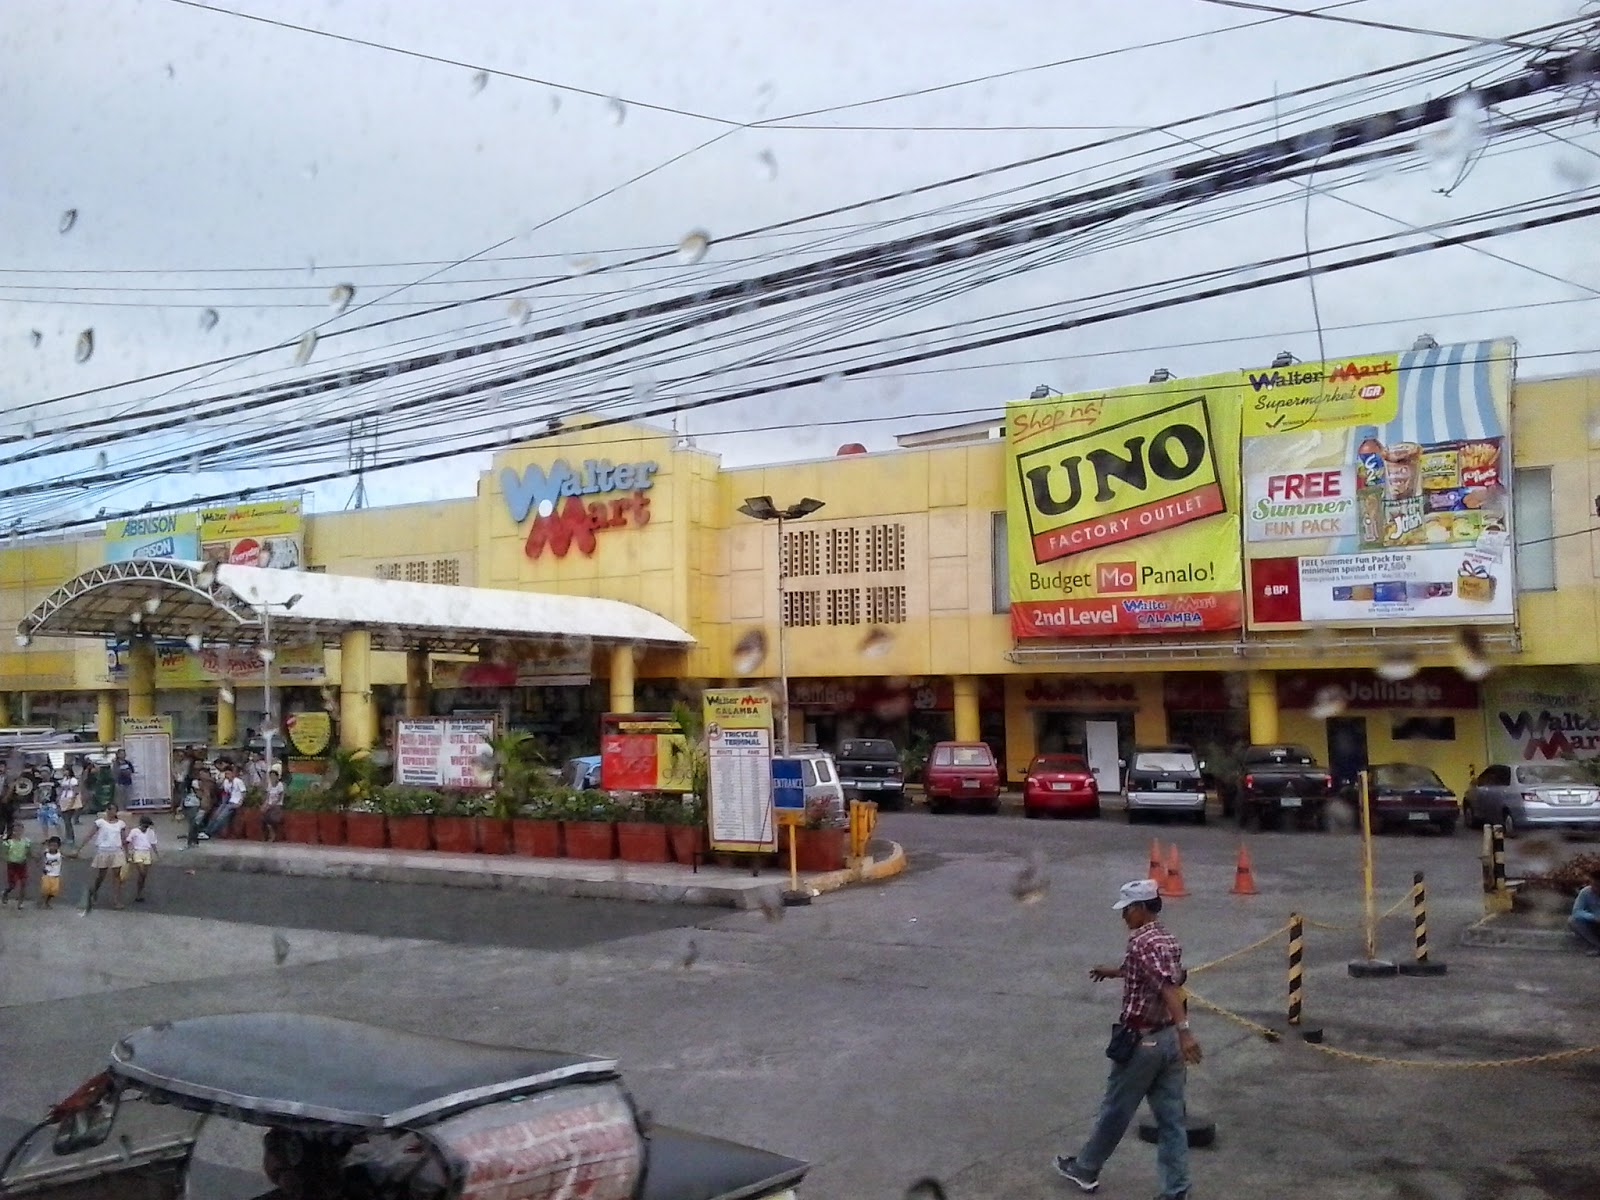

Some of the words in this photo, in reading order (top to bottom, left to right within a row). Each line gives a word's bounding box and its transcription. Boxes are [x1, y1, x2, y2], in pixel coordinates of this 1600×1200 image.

[1249, 370, 1323, 391] Walter
[1329, 361, 1392, 383] Mart
[1255, 385, 1356, 413] Supermarket
[1360, 385, 1382, 397] IGA
[1013, 408, 1065, 436] Shop
[1026, 424, 1205, 515] UNO
[501, 459, 658, 522] Walter
[1268, 471, 1341, 501] FREE
[1252, 498, 1351, 523] Summer
[121, 514, 177, 538] ABENSON
[525, 490, 650, 559] Mart
[1049, 516, 1129, 551] FACTORY
[1139, 496, 1204, 526] OUTLET
[1264, 520, 1295, 536] FUN
[1302, 518, 1340, 534] PACK
[1301, 567, 1340, 575] minimum
[1341, 564, 1366, 574] spend
[1372, 555, 1390, 563] Pack
[1030, 571, 1092, 594] Budget
[1101, 567, 1133, 587] Mo
[1141, 562, 1215, 586] Panalo!
[1273, 585, 1289, 596] BPI
[1122, 599, 1169, 612] Walter
[1173, 596, 1217, 611] Mart
[1034, 608, 1065, 626] 2nd
[1069, 605, 1118, 626] Level
[1137, 611, 1203, 624] CALAMBA
[1348, 680, 1442, 702] Jollibee
[715, 706, 759, 716] CALAMBA
[724, 731, 760, 739] TRICYCLE
[724, 738, 762, 747] TERMINAL
[774, 777, 803, 789] ENTRANCE
